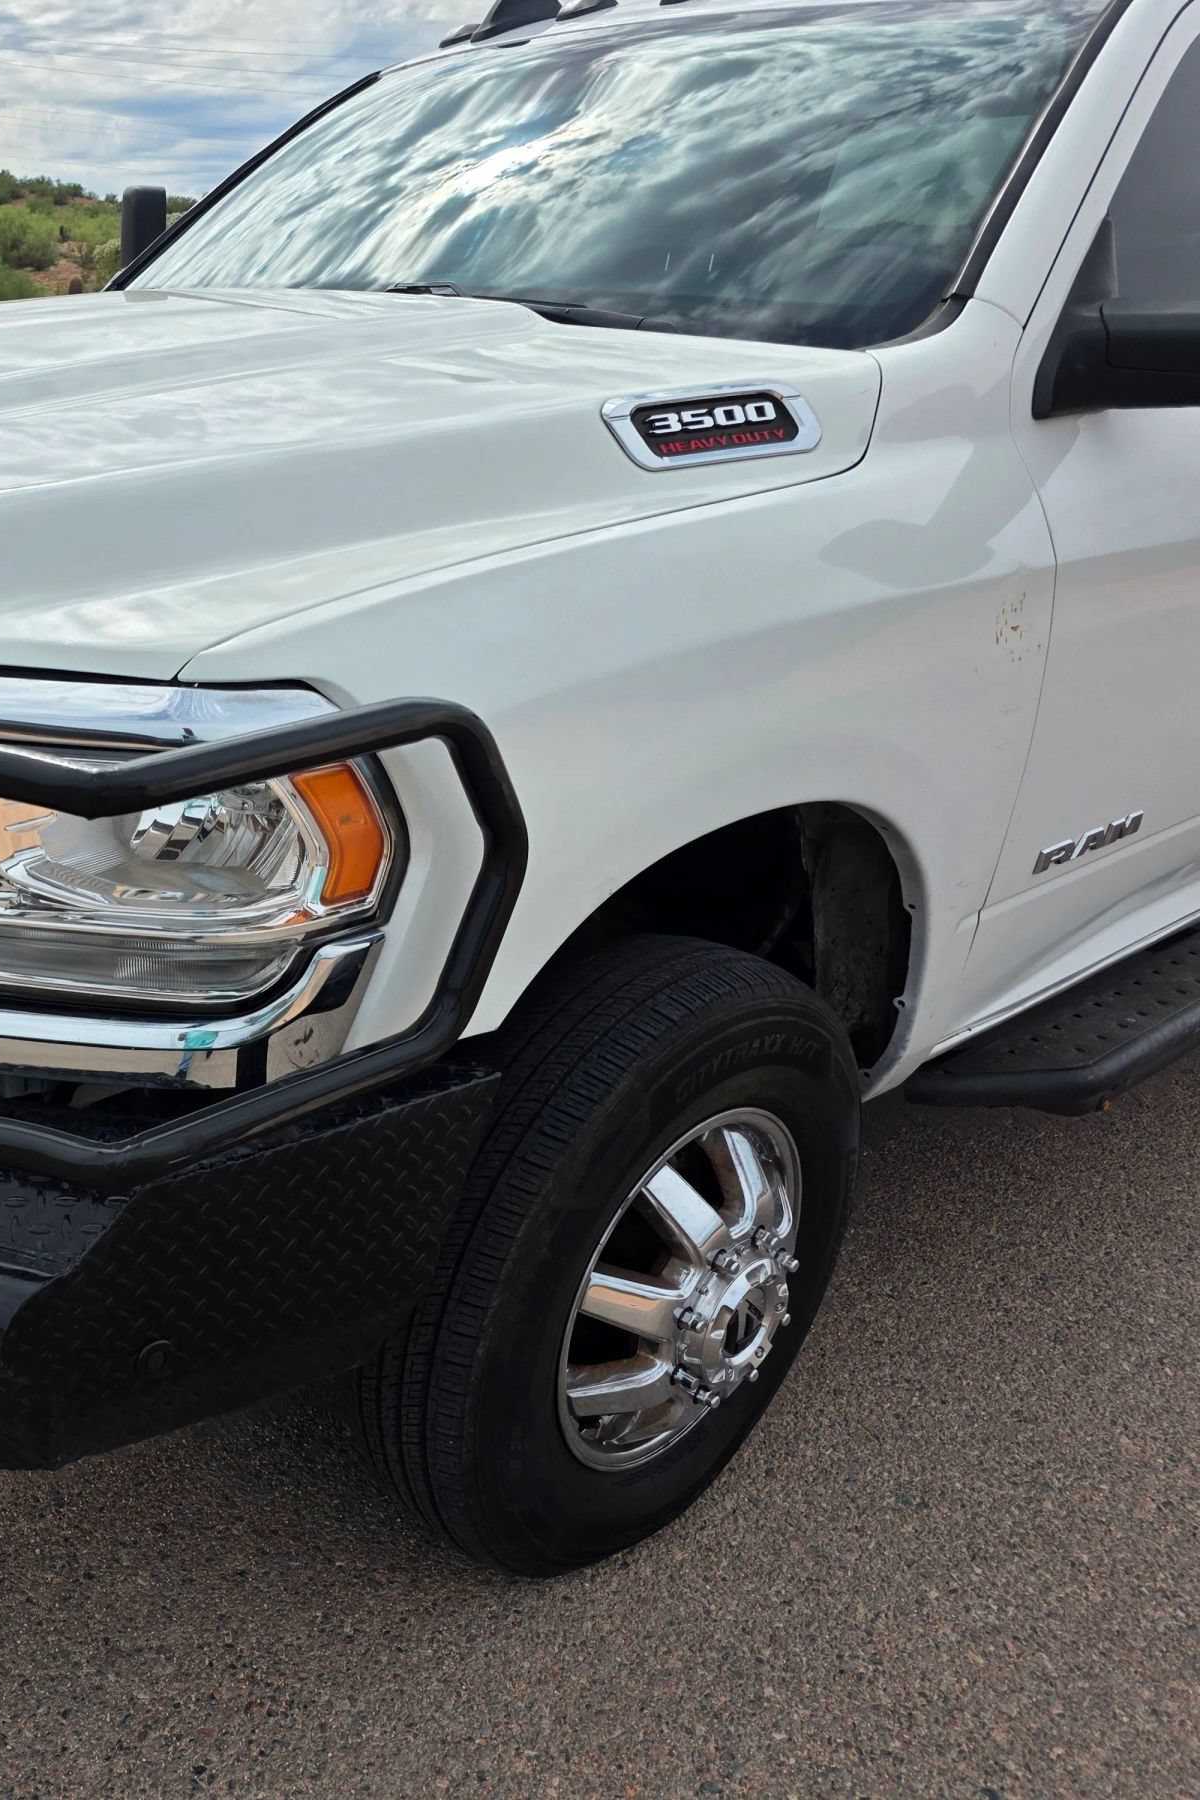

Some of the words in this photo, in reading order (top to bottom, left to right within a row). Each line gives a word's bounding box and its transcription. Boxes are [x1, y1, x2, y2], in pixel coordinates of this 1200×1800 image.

[646, 401, 776, 434] 3500
[659, 435, 728, 454] HEAVY
[732, 428, 785, 444] DUTY
[1032, 809, 1144, 875] RAM
